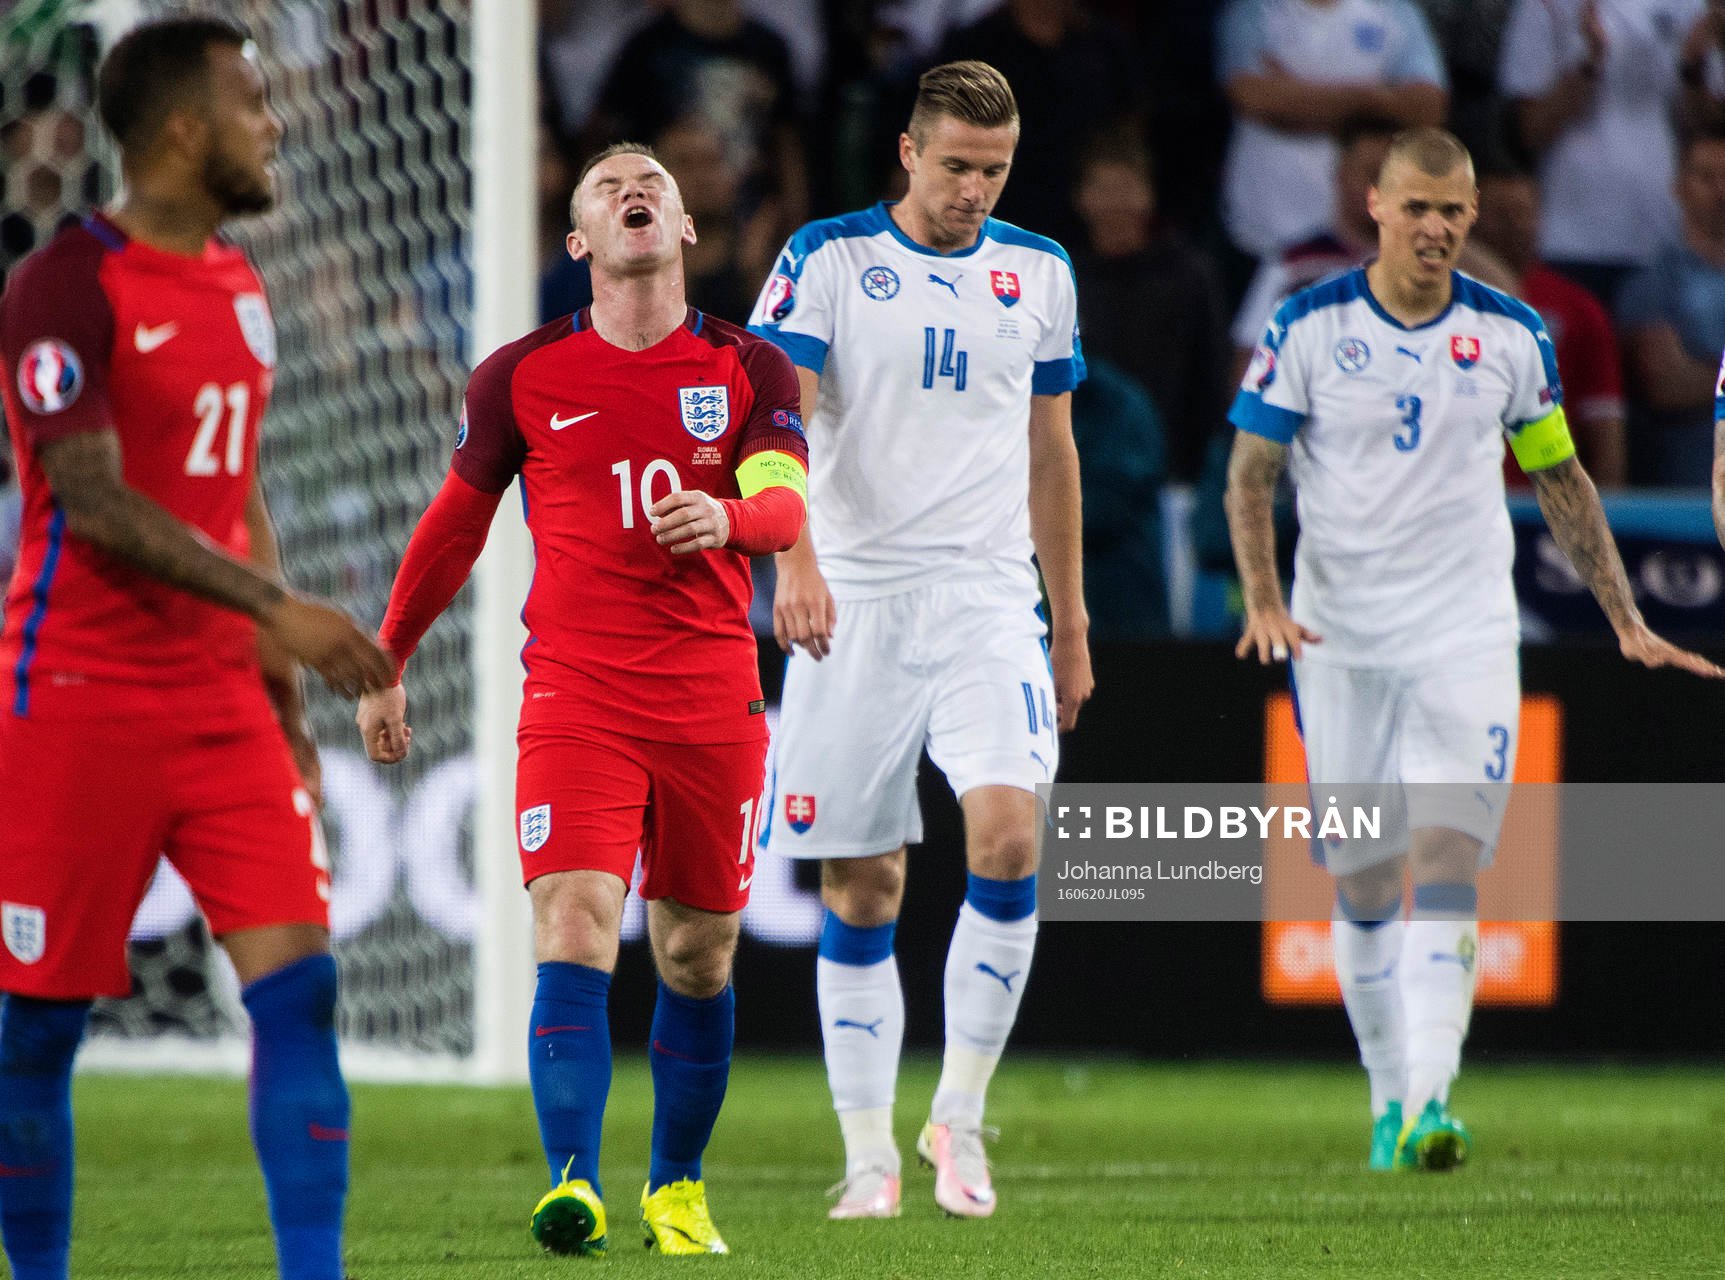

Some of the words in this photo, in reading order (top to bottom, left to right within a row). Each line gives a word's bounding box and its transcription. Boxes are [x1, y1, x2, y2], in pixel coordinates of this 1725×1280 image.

[922, 327, 968, 391] 14
[185, 381, 250, 477] 21
[1393, 395, 1422, 452] 3
[611, 458, 683, 529] 10
[760, 460, 776, 468] NO
[1021, 682, 1055, 750] 14
[1484, 724, 1508, 782] 3
